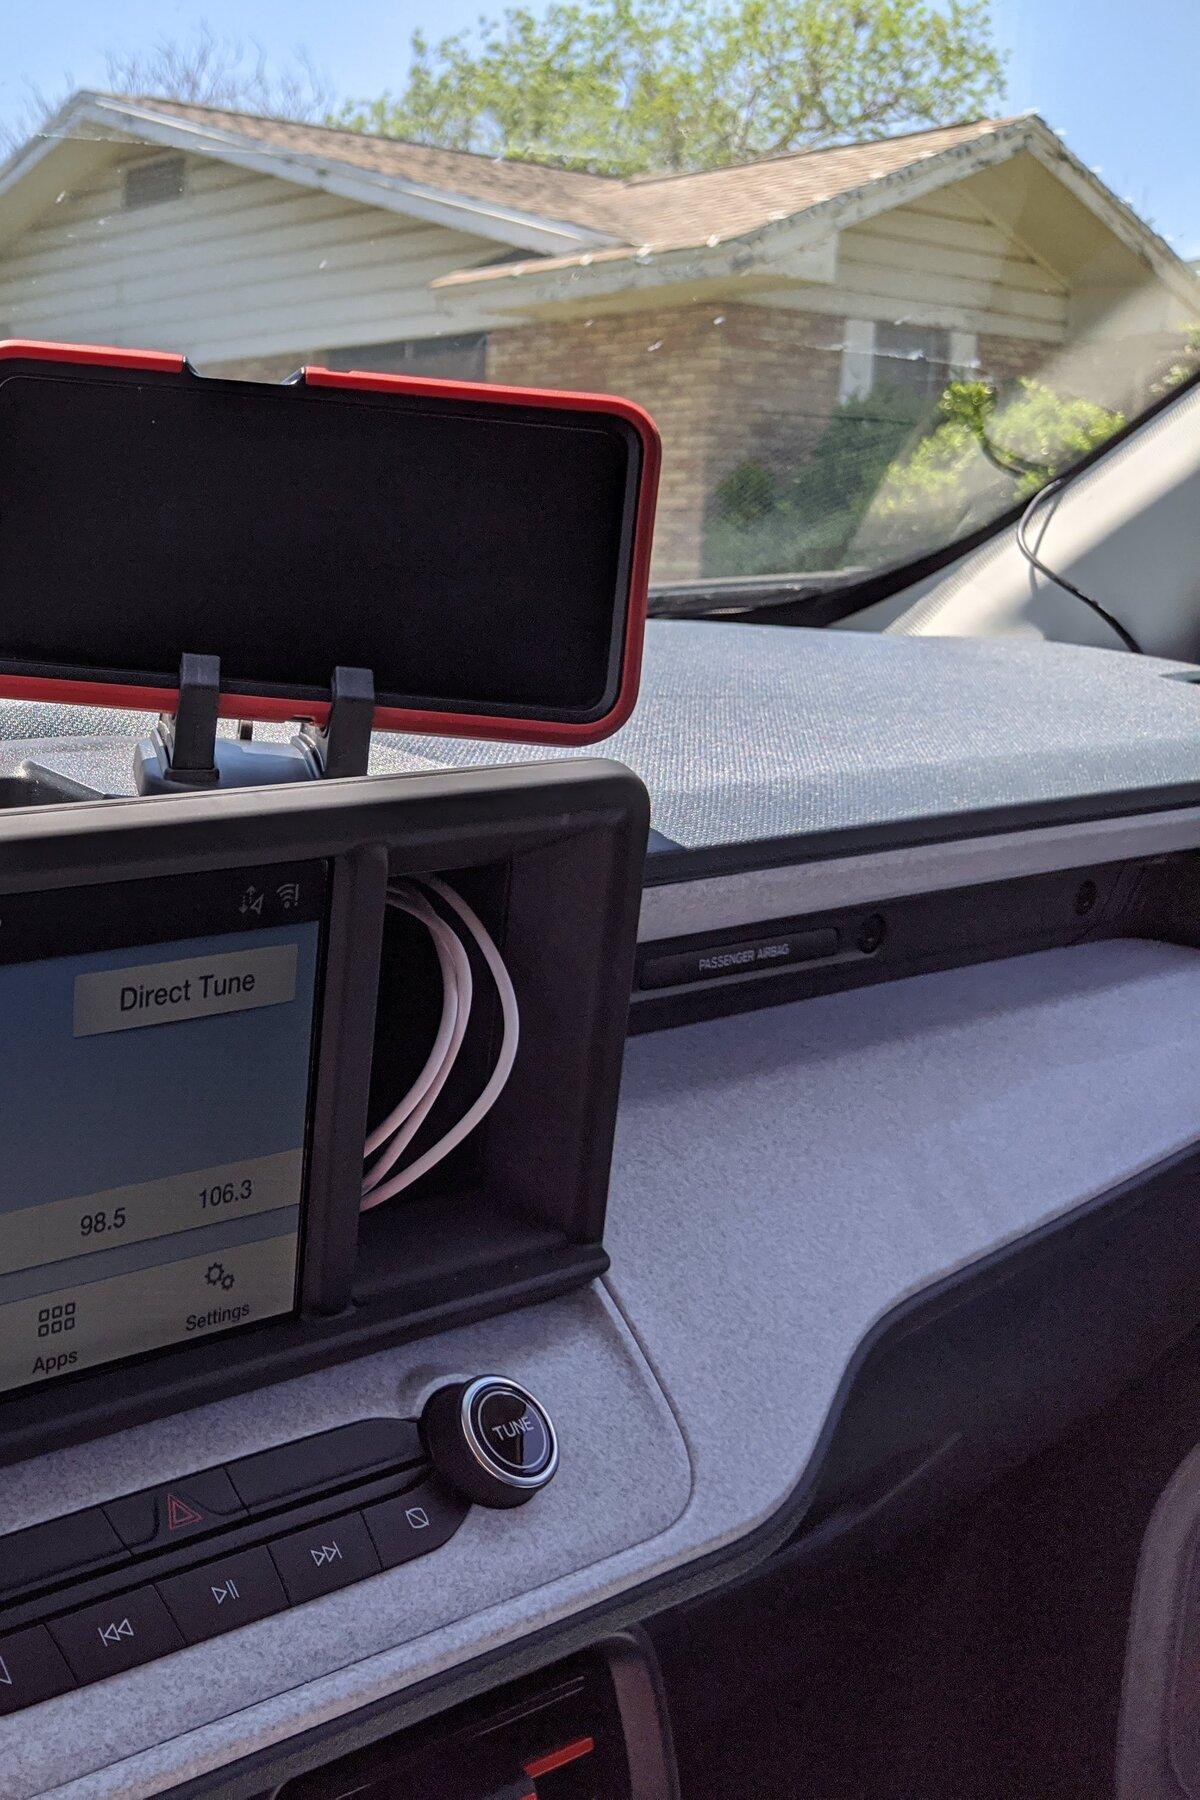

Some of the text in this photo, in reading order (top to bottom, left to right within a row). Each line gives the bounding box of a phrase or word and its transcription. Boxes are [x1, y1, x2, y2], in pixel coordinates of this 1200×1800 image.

[698, 943, 790, 972] PASSENGER AIRBAG
[119, 969, 256, 1012] Direct Tune
[197, 1178, 253, 1210] 106.3
[79, 1207, 127, 1237] 98.5
[185, 1301, 251, 1334] Settings
[31, 1347, 78, 1377] Apps
[492, 1416, 535, 1441] TUNE
